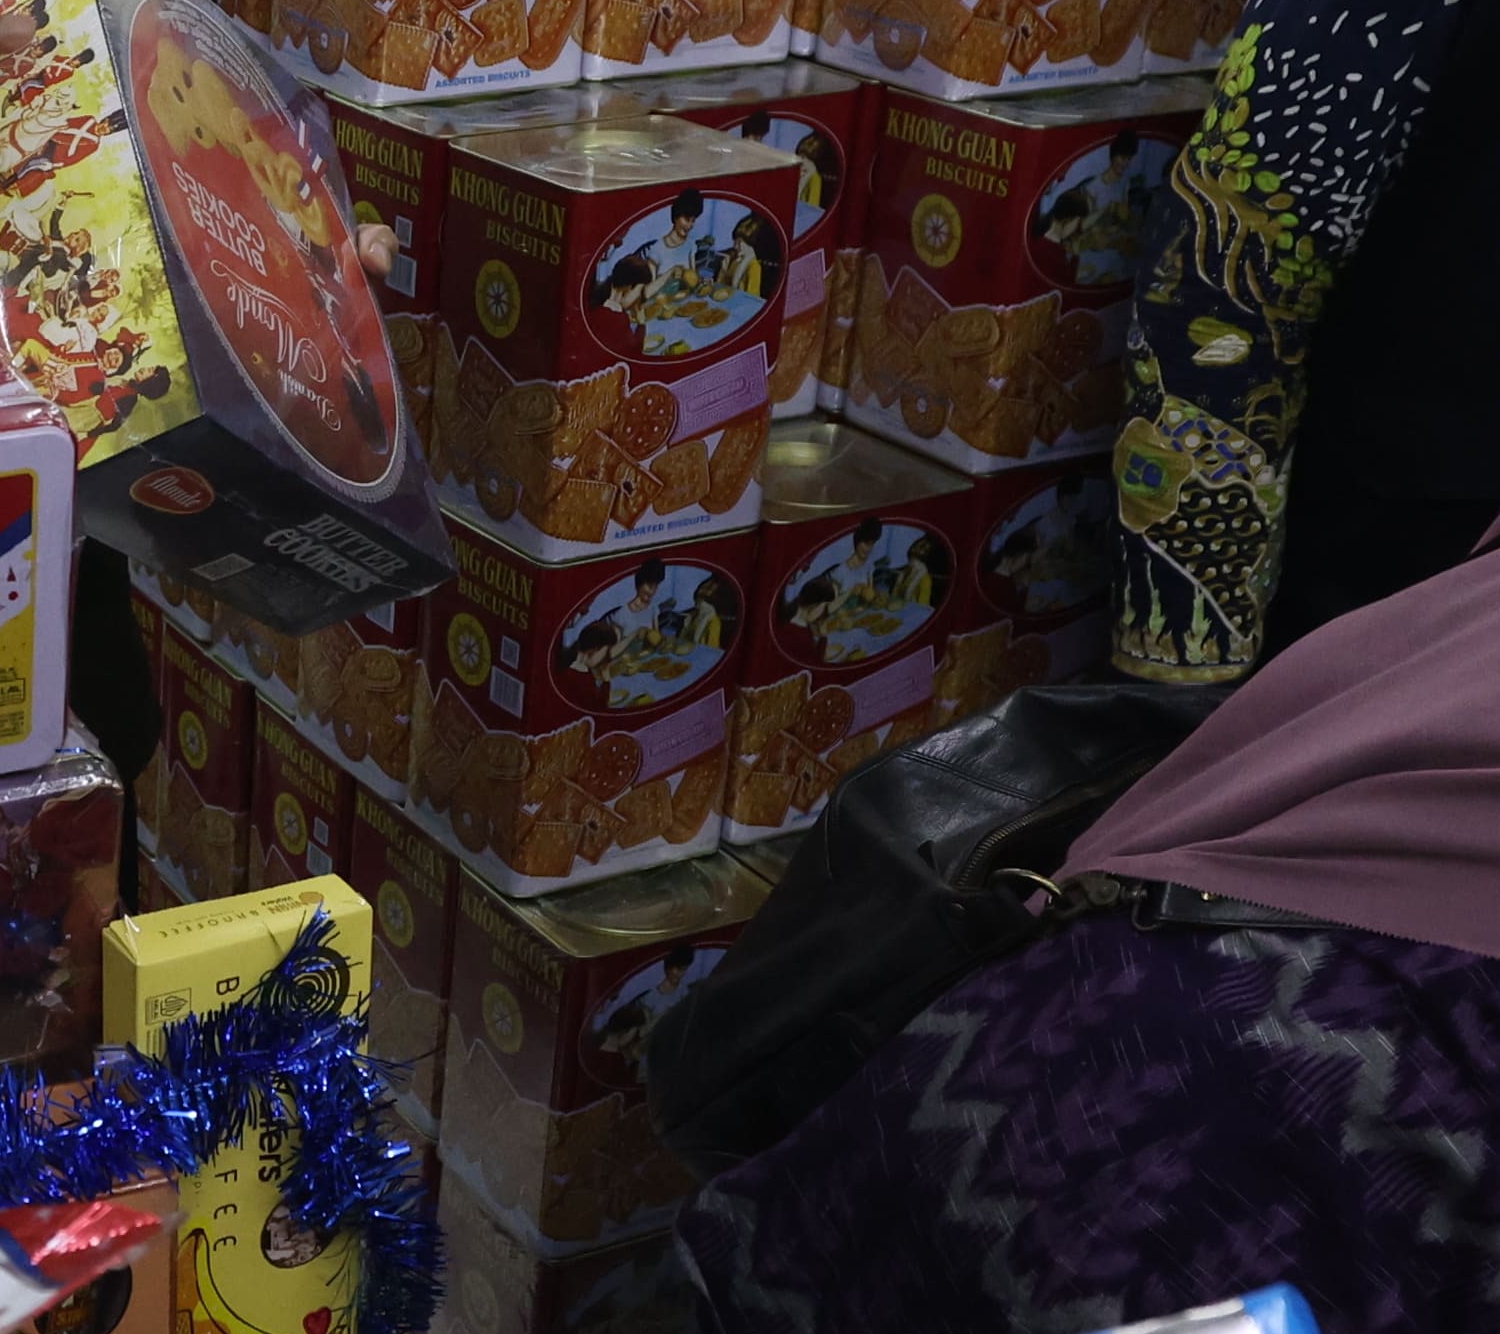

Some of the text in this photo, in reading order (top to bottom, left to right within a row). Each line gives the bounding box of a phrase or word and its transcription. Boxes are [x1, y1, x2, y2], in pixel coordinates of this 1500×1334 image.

[334, 118, 424, 180] HONG GUAN
[886, 107, 1016, 172] KHONG GUAN
[172, 161, 266, 254] COOKIES
[355, 164, 420, 206] BISCUITS
[450, 166, 567, 239] KHONG GUAN
[925, 157, 1010, 199] BISCUITS
[191, 198, 267, 276] BUTTER
[486, 219, 561, 266] BISCUITS
[298, 512, 409, 577] BUTTER
[451, 535, 534, 608] ONG GUAN
[457, 575, 529, 631] BISCUITS
